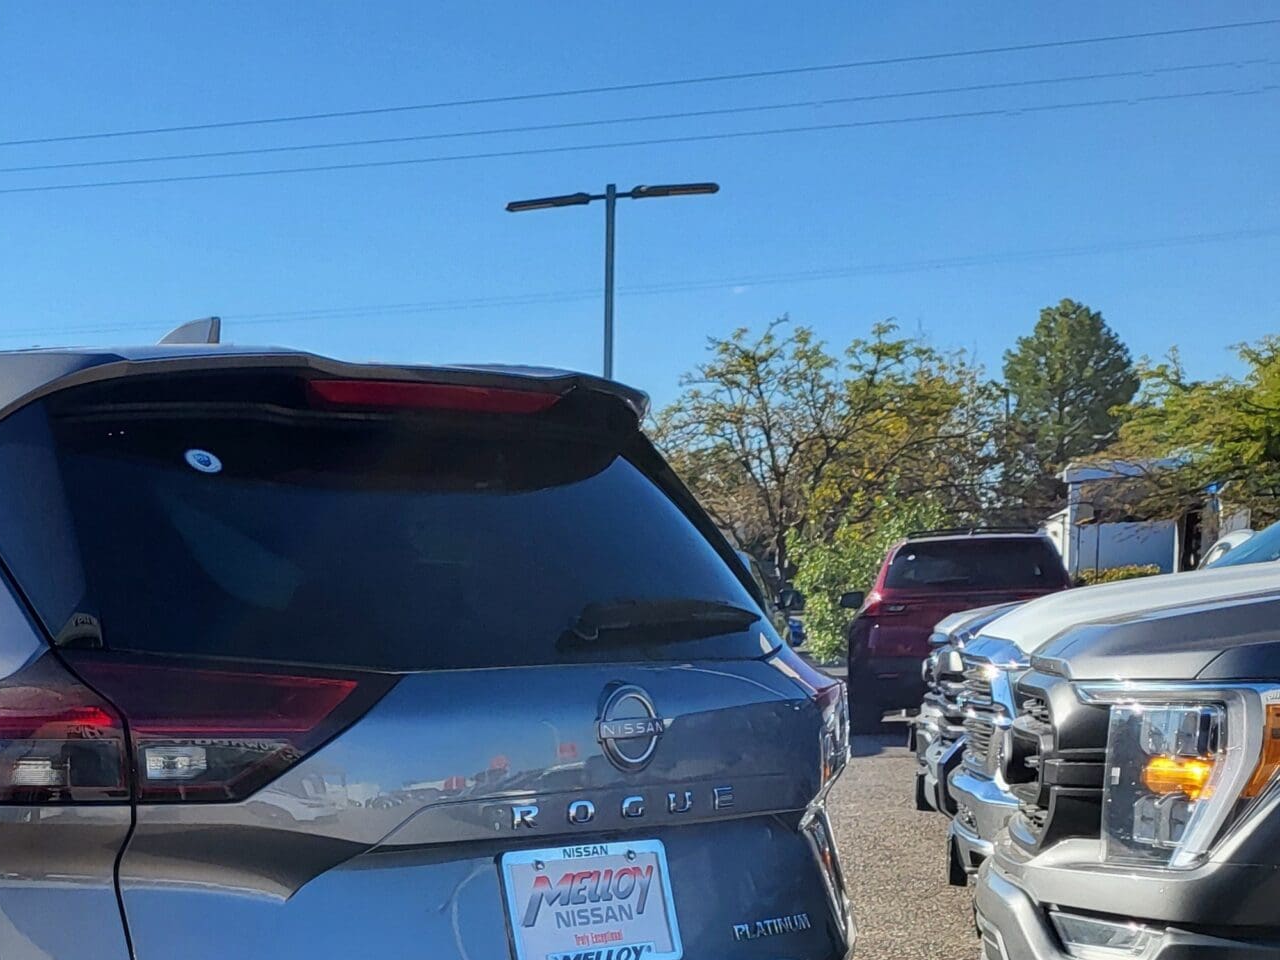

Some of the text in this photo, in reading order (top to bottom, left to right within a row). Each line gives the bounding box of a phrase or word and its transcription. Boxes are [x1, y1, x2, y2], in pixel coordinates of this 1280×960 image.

[602, 720, 664, 737] NISSAN
[511, 786, 734, 830] ROGUE
[562, 845, 609, 859] NISSAN
[521, 865, 654, 928] MELLOY
[555, 904, 634, 929] NISSAN
[733, 913, 811, 941] PLATINUM
